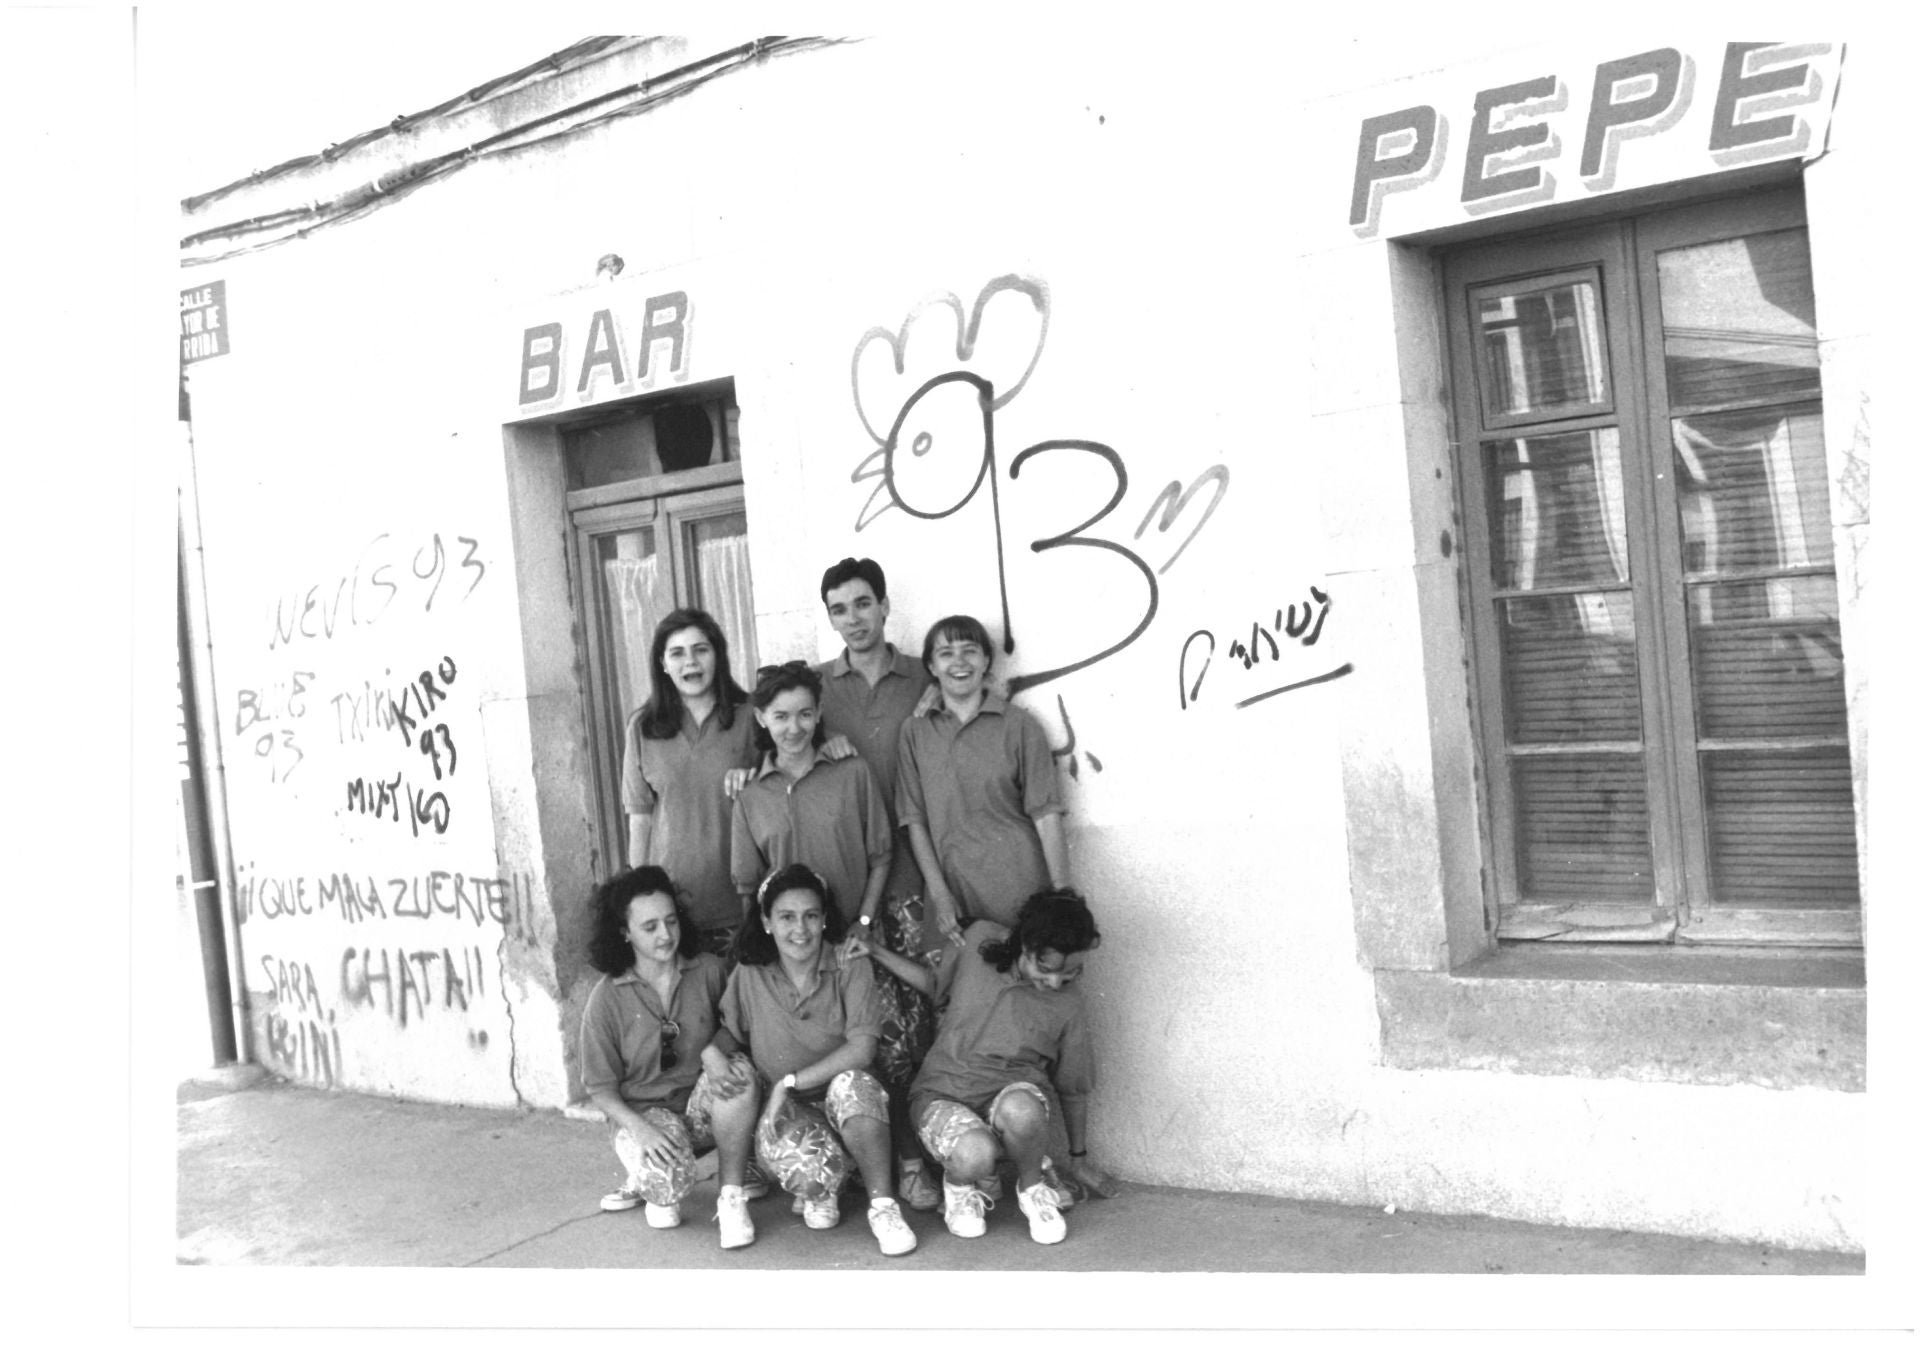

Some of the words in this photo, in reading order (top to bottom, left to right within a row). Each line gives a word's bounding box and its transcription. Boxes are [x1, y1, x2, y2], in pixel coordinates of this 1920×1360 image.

[1349, 42, 1829, 238] PEPE
[181, 287, 213, 309] ALLE
[519, 290, 694, 414] BAR
[413, 533, 485, 612] 93
[236, 672, 315, 735] BLE
[255, 730, 303, 783] 93
[420, 723, 457, 780] 93
[318, 873, 387, 923] MALA
